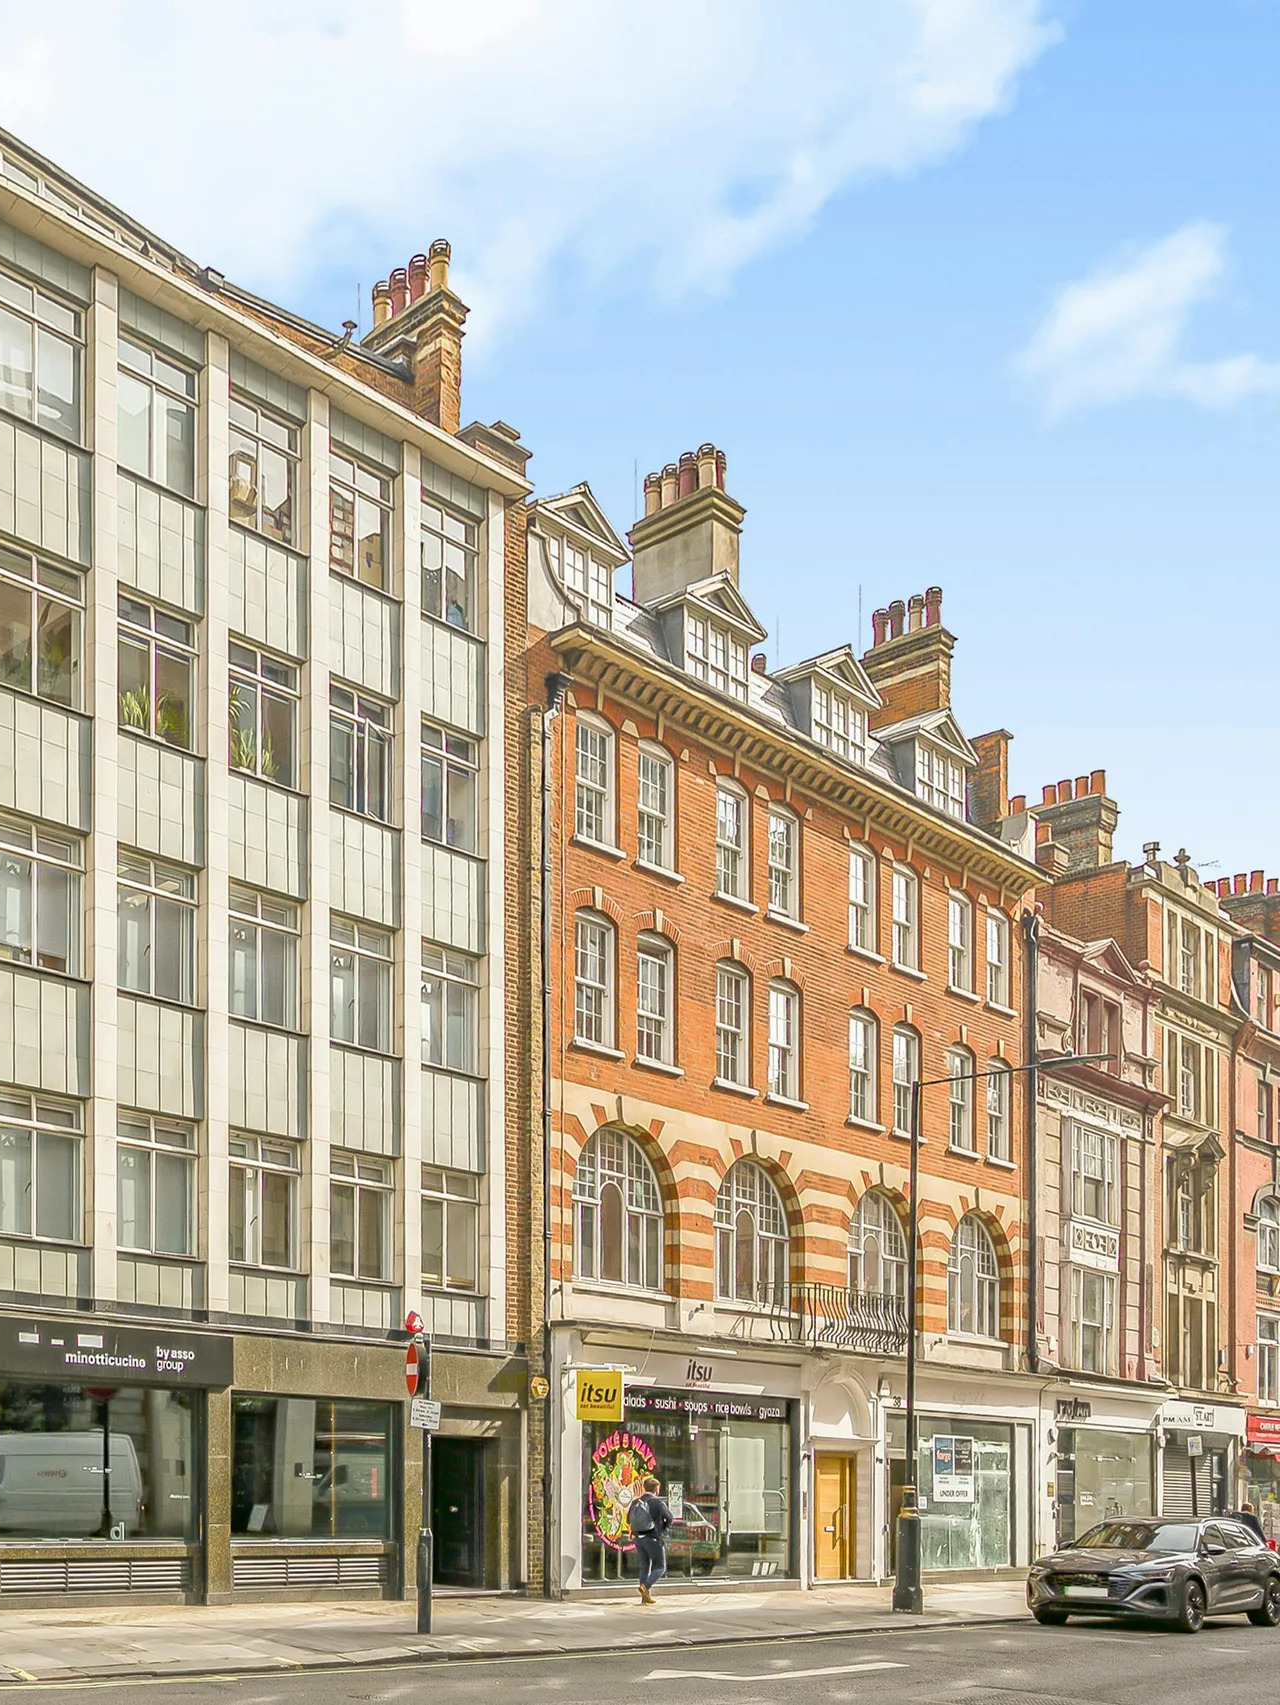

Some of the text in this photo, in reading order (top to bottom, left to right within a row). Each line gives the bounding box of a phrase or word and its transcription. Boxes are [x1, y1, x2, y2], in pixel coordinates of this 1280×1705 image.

[65, 1351, 146, 1368] minotticucine
[156, 1346, 195, 1360] by asso
[156, 1360, 184, 1372] group
[686, 1358, 712, 1381] itsu
[580, 1382, 617, 1402] itsu
[624, 1394, 780, 1419] alads sushi soups rice bowls gyoza
[592, 1430, 620, 1466] POKÉ
[632, 1435, 656, 1470] WAYS
